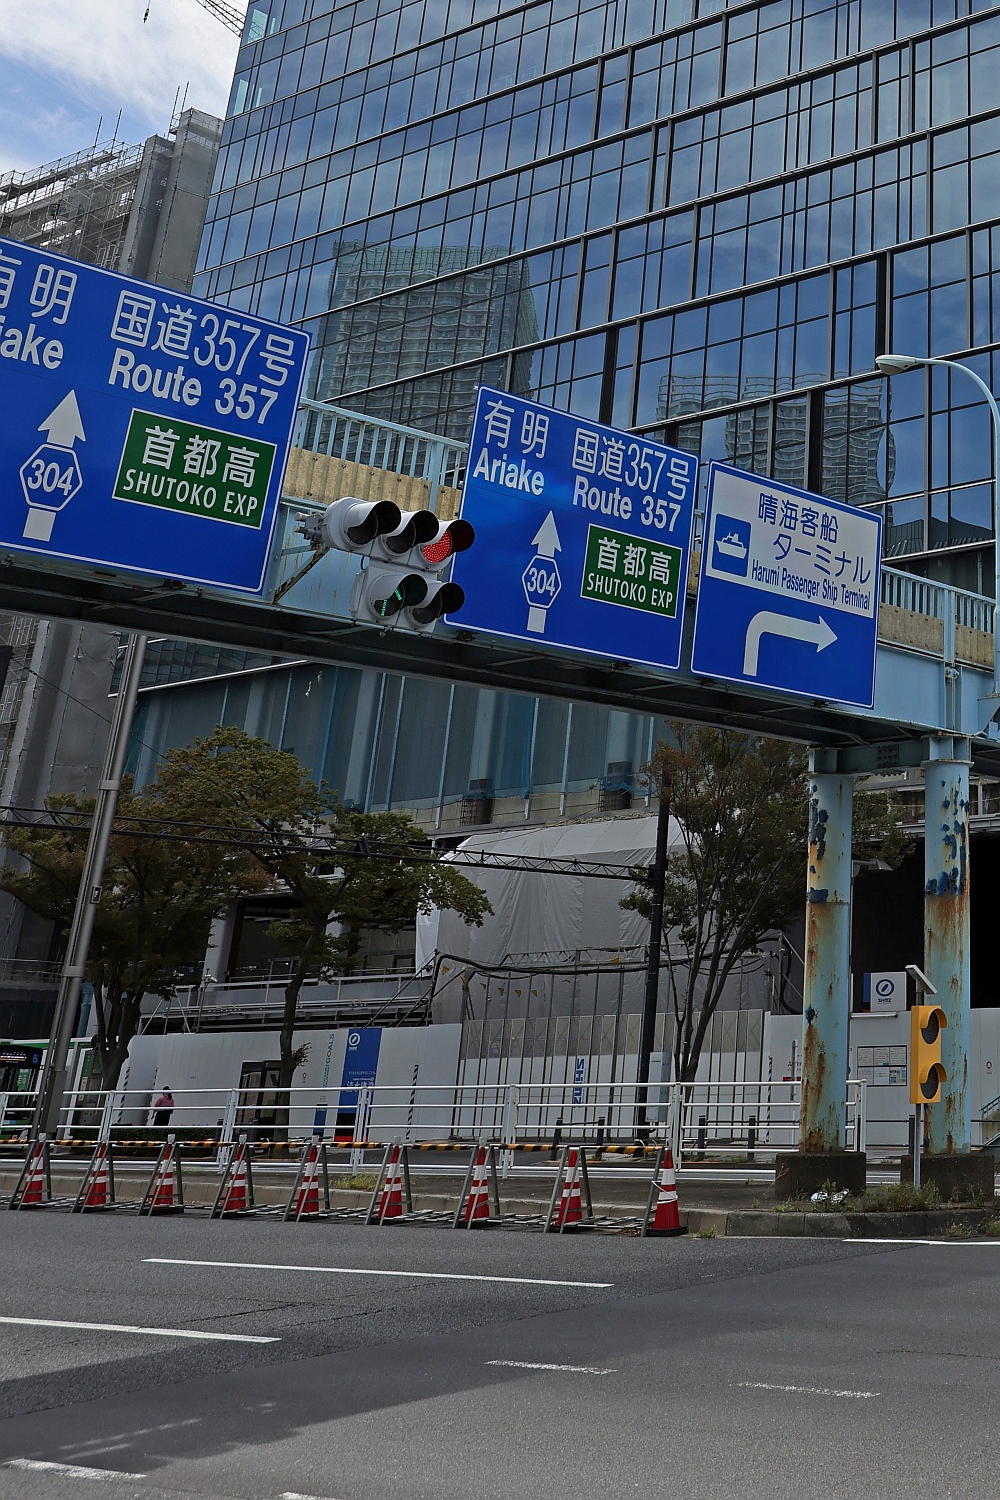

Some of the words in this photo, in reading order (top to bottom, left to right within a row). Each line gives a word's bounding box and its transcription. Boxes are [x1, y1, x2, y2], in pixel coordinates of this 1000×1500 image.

[0, 316, 64, 370] ake
[110, 289, 295, 387] 国道357号
[108, 347, 202, 407] Route
[214, 377, 279, 425] 357
[484, 399, 550, 459] 有明
[27, 458, 75, 496] 304
[141, 424, 260, 488] 首都高
[472, 447, 545, 496] Ariake
[571, 427, 691, 501] 国道357号
[123, 468, 217, 509] SHUTOKO
[223, 490, 258, 517] EXP
[572, 474, 632, 520] Route
[640, 495, 682, 532] 357
[758, 492, 839, 544] 晴海客船
[527, 567, 556, 597] 304
[597, 536, 672, 586] 首都高
[751, 559, 780, 587] Harumi
[781, 567, 820, 599] Passenger
[822, 578, 838, 605] Ship
[841, 583, 871, 610] Terminal
[773, 533, 871, 585] ターミナル
[586, 572, 647, 603] SHUTOKO
[650, 587, 673, 609] EXP
